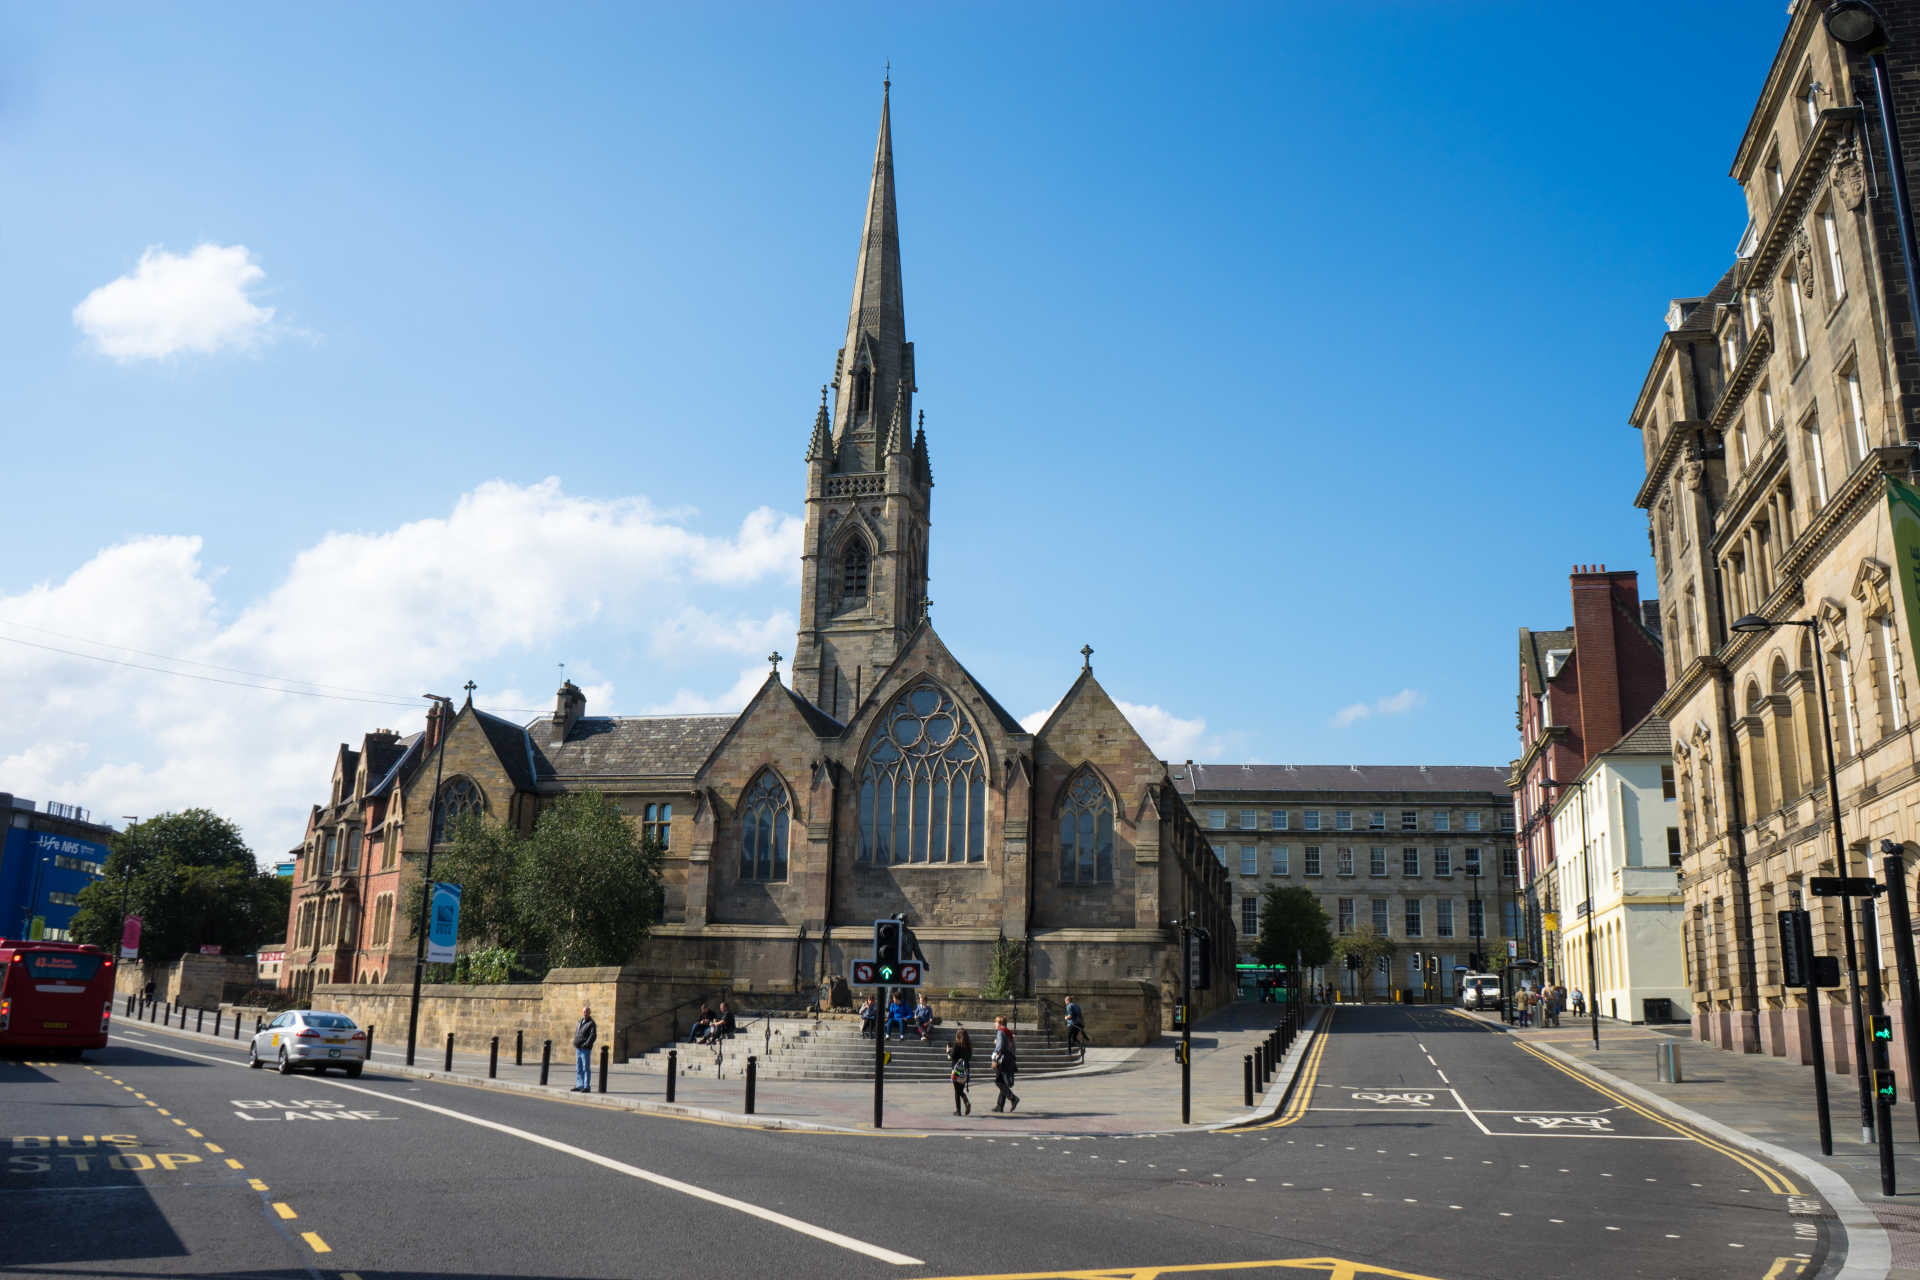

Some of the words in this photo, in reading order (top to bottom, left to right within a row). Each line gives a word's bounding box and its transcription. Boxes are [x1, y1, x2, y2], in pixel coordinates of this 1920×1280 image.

[61, 841, 80, 854] NHS
[230, 1100, 346, 1109] BUS
[234, 1110, 399, 1121] LANE
[12, 1134, 144, 1149] BUS
[8, 1153, 203, 1174] STOP
